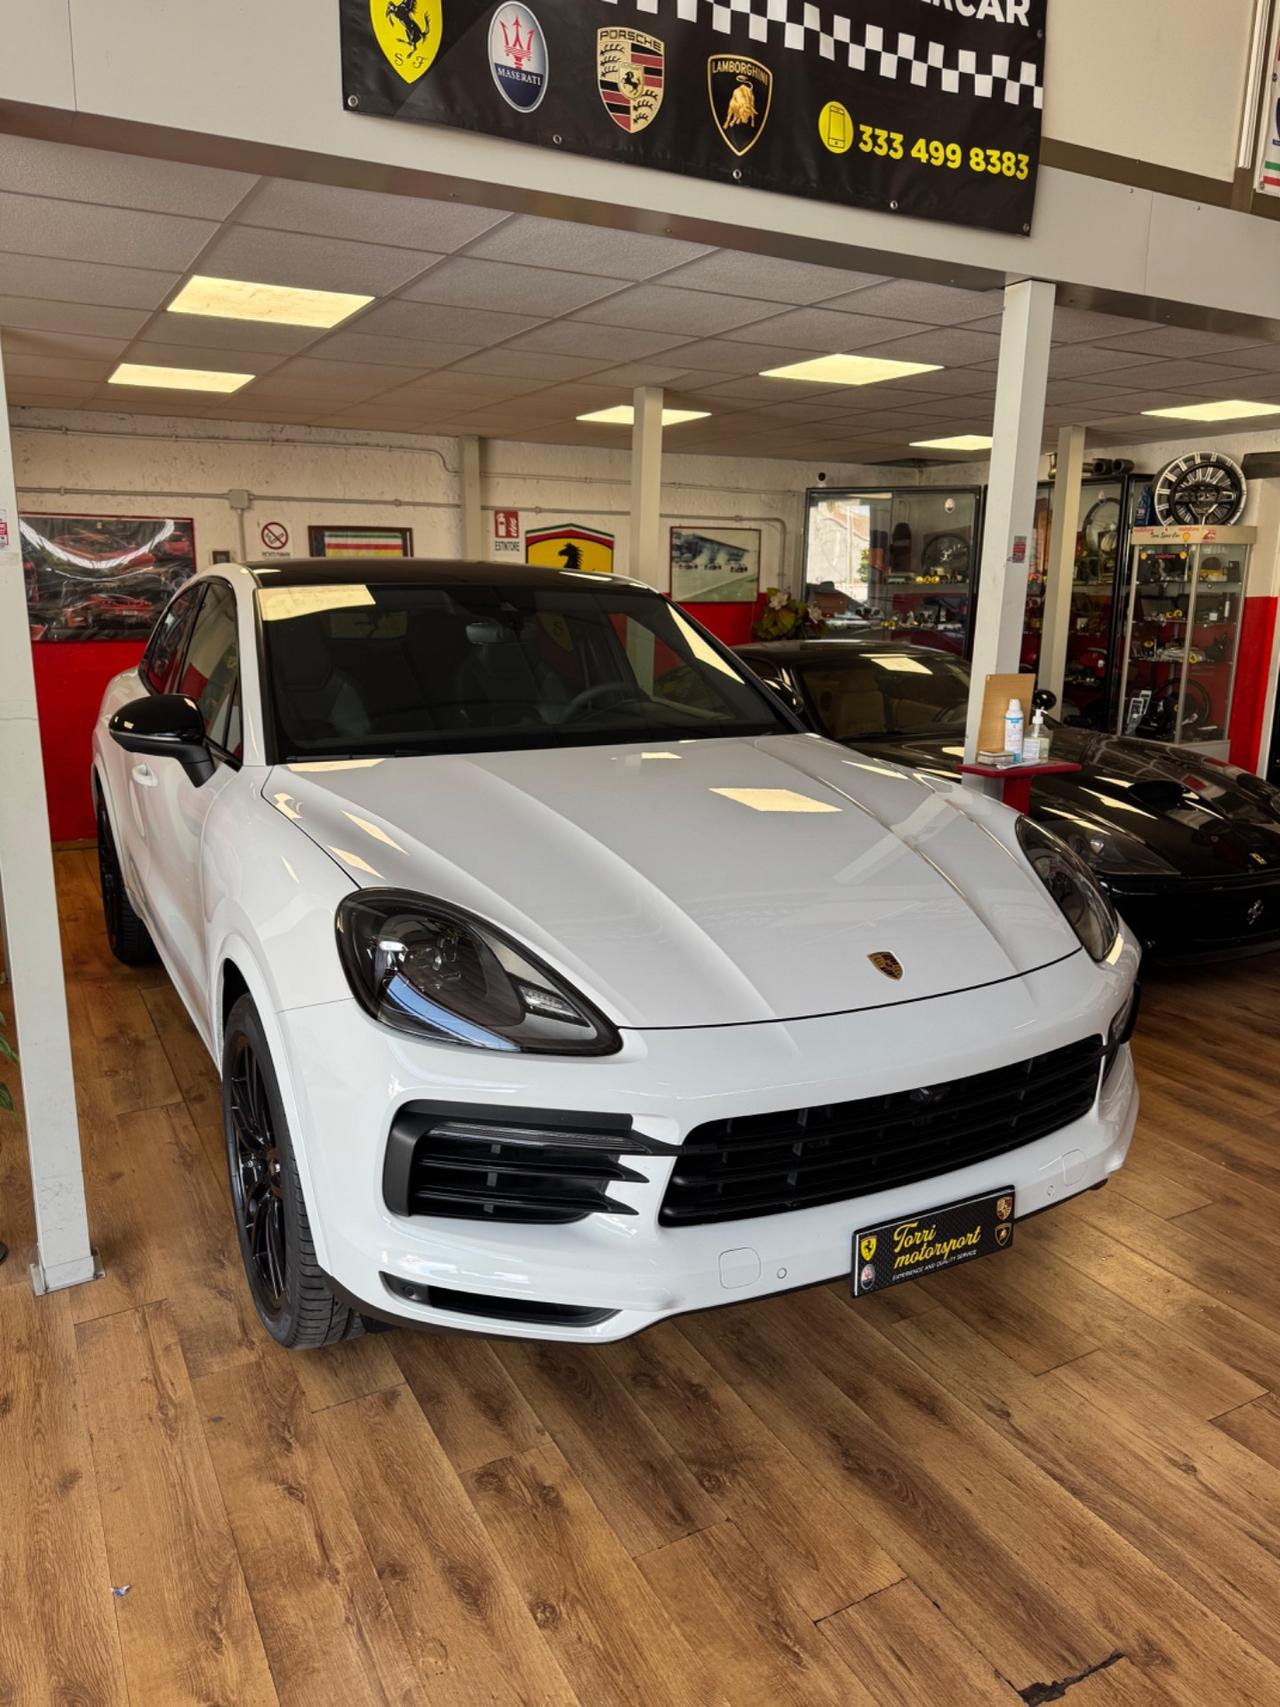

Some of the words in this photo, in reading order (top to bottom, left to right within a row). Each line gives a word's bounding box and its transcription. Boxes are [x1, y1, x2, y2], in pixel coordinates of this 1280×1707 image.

[600, 29, 662, 50] PORSCHE
[497, 67, 541, 86] MASERATI
[712, 60, 768, 86] LAMBORGHINI
[858, 124, 904, 160] 333
[910, 138, 962, 169] 499
[969, 147, 1030, 180] 8383
[893, 1221, 937, 1253] Torri
[893, 1225, 981, 1269] motorsport
